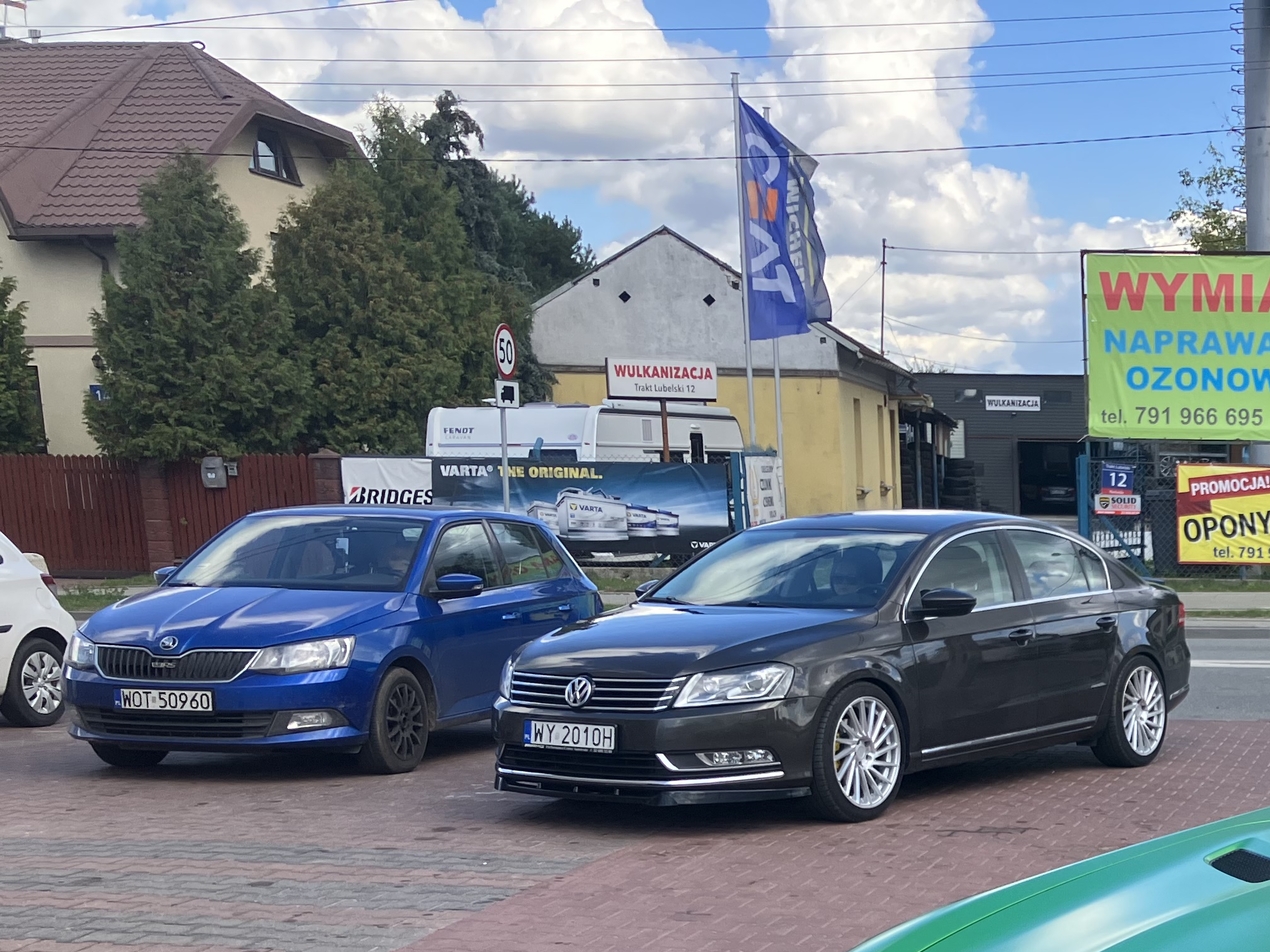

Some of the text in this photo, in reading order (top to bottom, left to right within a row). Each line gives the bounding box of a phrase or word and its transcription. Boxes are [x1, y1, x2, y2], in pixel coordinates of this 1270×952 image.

[499, 338, 513, 365] 50
[614, 364, 713, 380] WULKANIZACJA
[634, 383, 695, 393] Trakt Lubelski 12
[987, 399, 1039, 408] WULKANIZACJA
[1101, 410, 1127, 424] tel.
[1135, 407, 1170, 424] 791
[1180, 408, 1217, 425] 966
[1226, 408, 1263, 426] 695
[529, 466, 603, 479] ORIGINAL.
[1110, 472, 1127, 487] 12
[349, 487, 432, 505] BRIDGES
[579, 504, 602, 513] VARTA
[1213, 547, 1234, 558] tel.
[1239, 547, 1264, 558] 791
[122, 691, 151, 708] WOT
[159, 692, 210, 709] 50960
[534, 723, 555, 743] WY
[562, 726, 613, 748] 2010H
